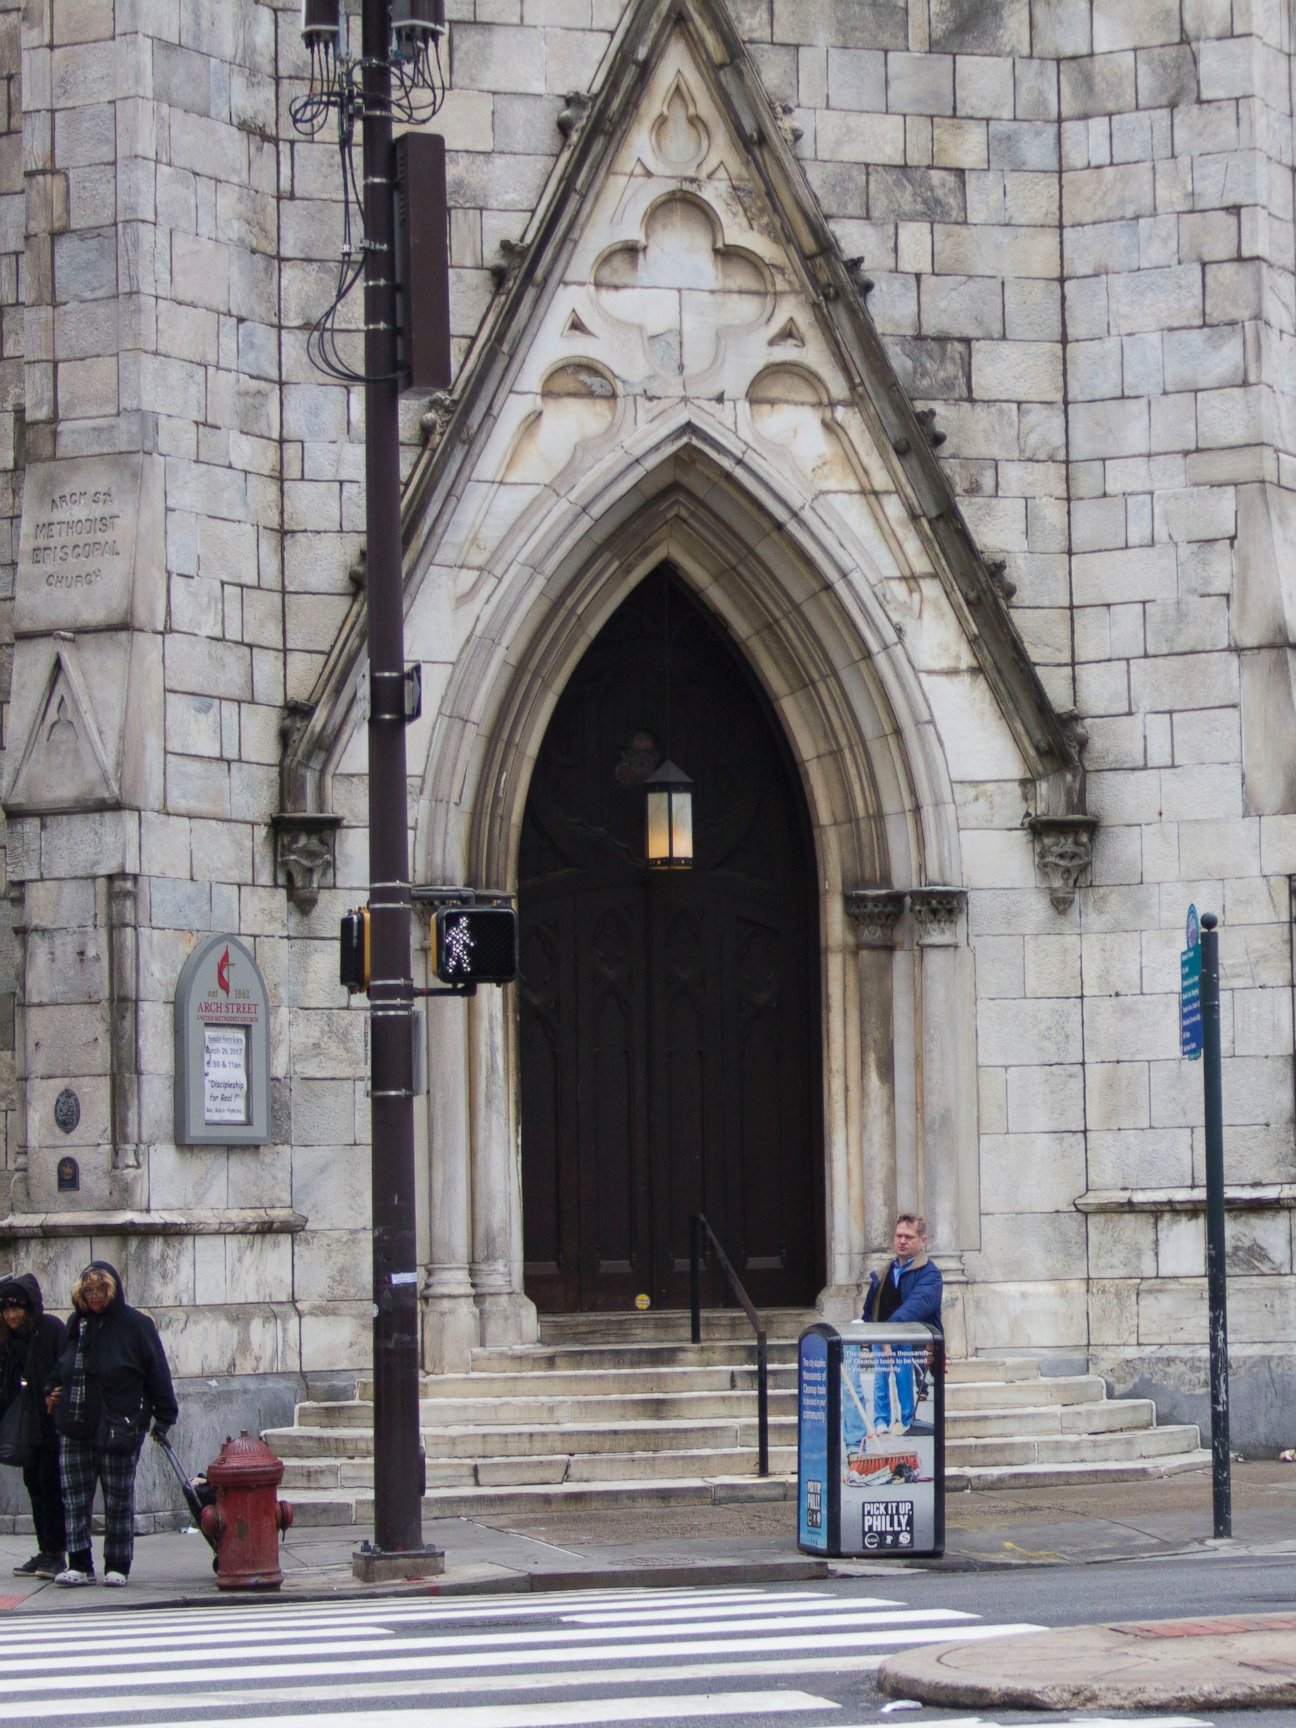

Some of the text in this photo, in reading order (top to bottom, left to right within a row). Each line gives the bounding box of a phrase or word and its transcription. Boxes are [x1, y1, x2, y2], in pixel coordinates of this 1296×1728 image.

[50, 491, 87, 512] ARCH
[34, 514, 120, 540] METHODIST
[32, 540, 121, 565] EPISCOPAL
[46, 568, 102, 589] CHURCH
[197, 1002, 259, 1014] ARCH STREET
[209, 1093, 219, 1102] for
[864, 1502, 912, 1515] PICK IT UP,
[864, 1514, 910, 1532] PHILLY.
